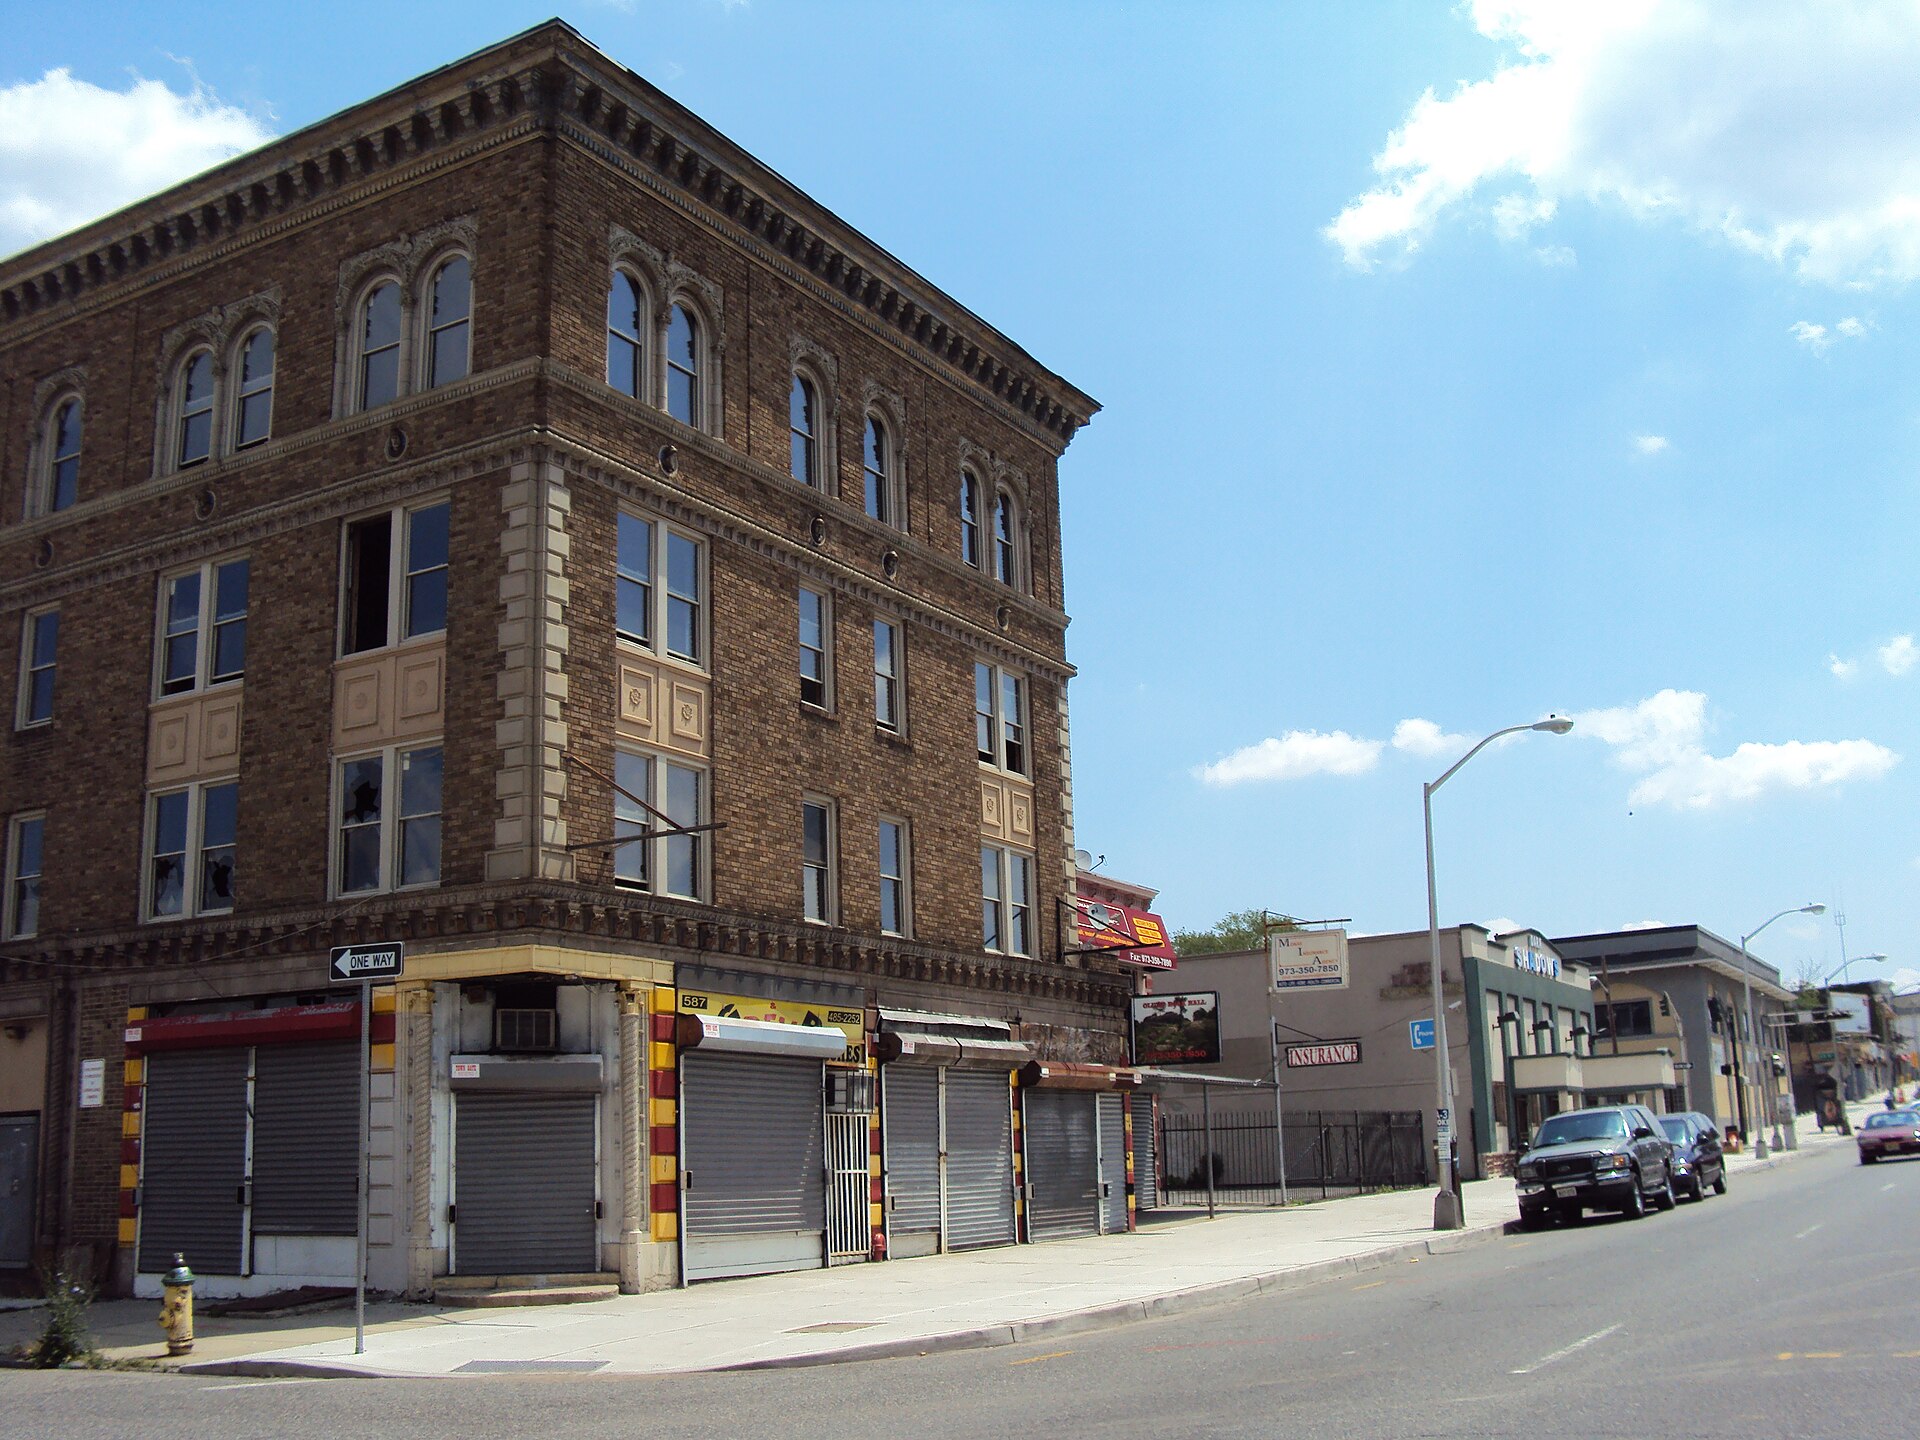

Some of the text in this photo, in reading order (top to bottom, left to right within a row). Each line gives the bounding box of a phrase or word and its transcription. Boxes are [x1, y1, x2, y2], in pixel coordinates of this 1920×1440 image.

[350, 952, 394, 969] ONE WAY
[1514, 946, 1559, 978] SHADOWS
[1279, 964, 1340, 976] 973-350-7850
[683, 996, 707, 1008] 587
[828, 1011, 860, 1024] 485-2252
[1289, 1045, 1359, 1067] INSURANCE
